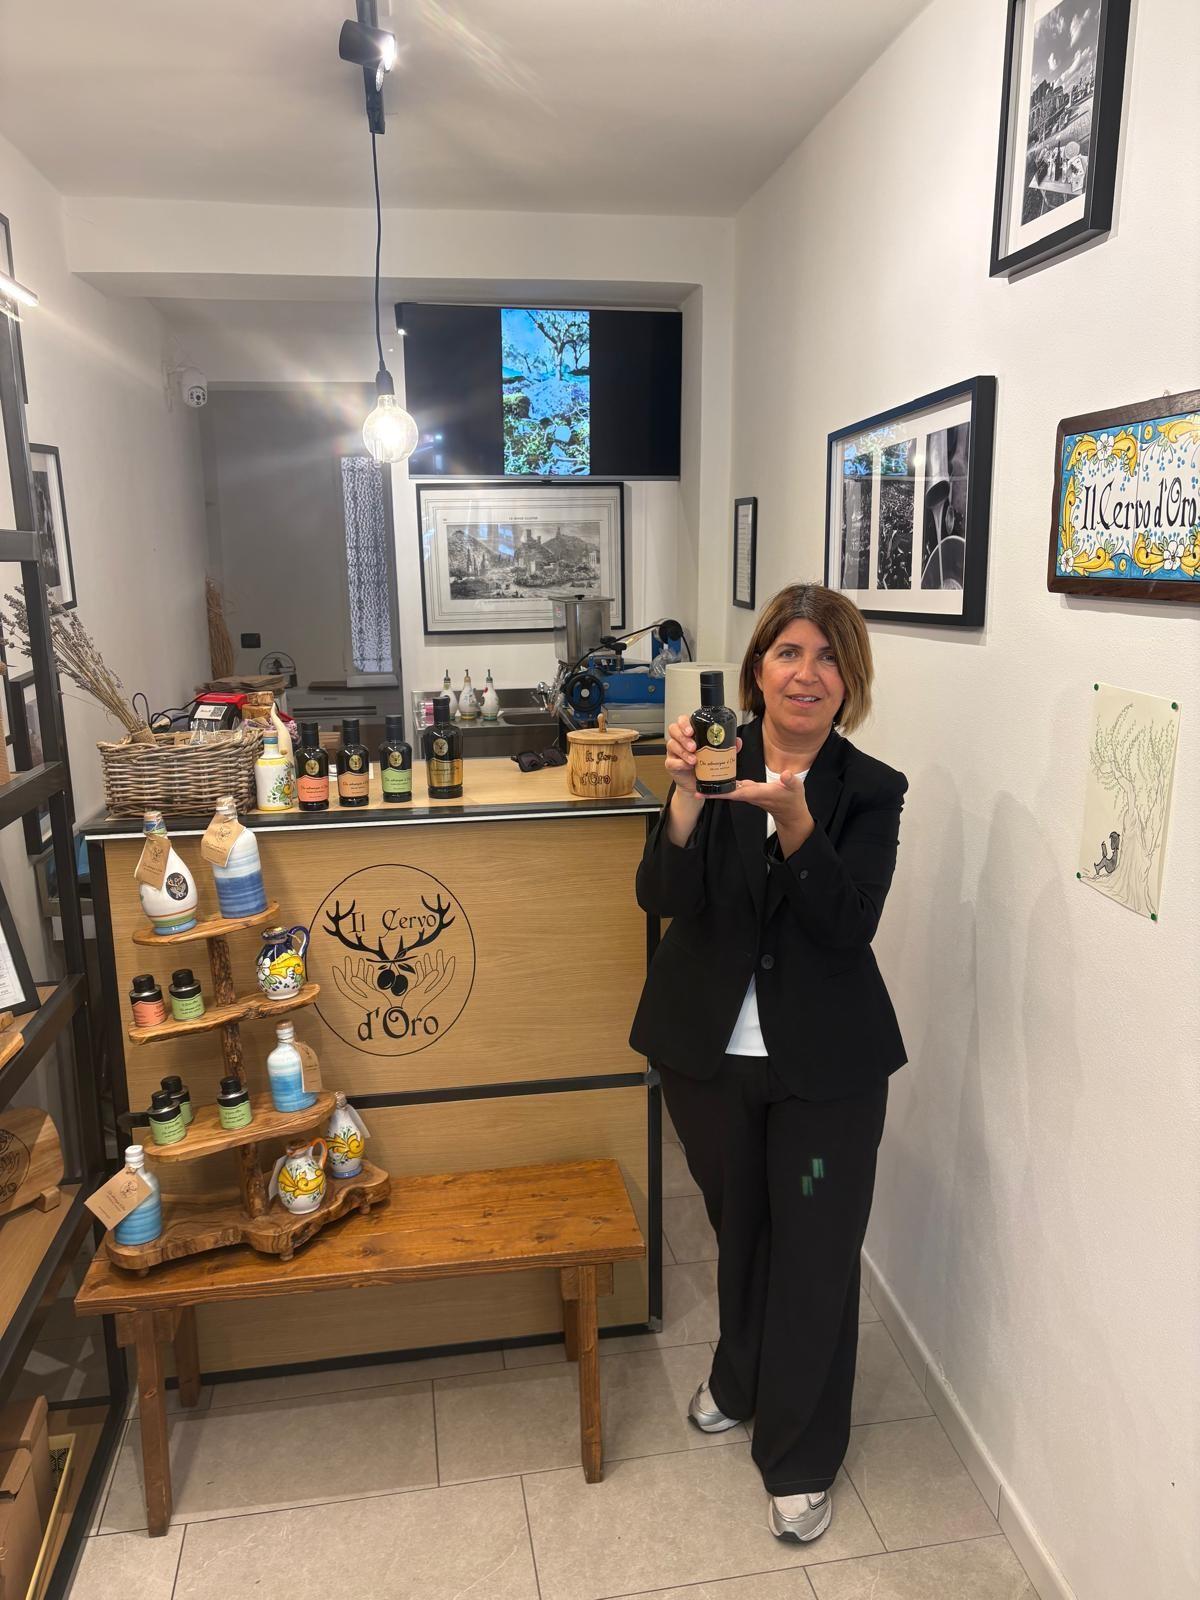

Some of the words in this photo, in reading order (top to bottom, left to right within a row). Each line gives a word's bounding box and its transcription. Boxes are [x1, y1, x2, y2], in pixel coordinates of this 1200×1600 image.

[1081, 486, 1097, 531] Il
[1097, 477, 1150, 531] Cervo
[1153, 476, 1197, 528] d'Oro
[350, 911, 366, 933] Il
[381, 907, 437, 938] Cervo
[357, 1006, 439, 1041] d'Oro
